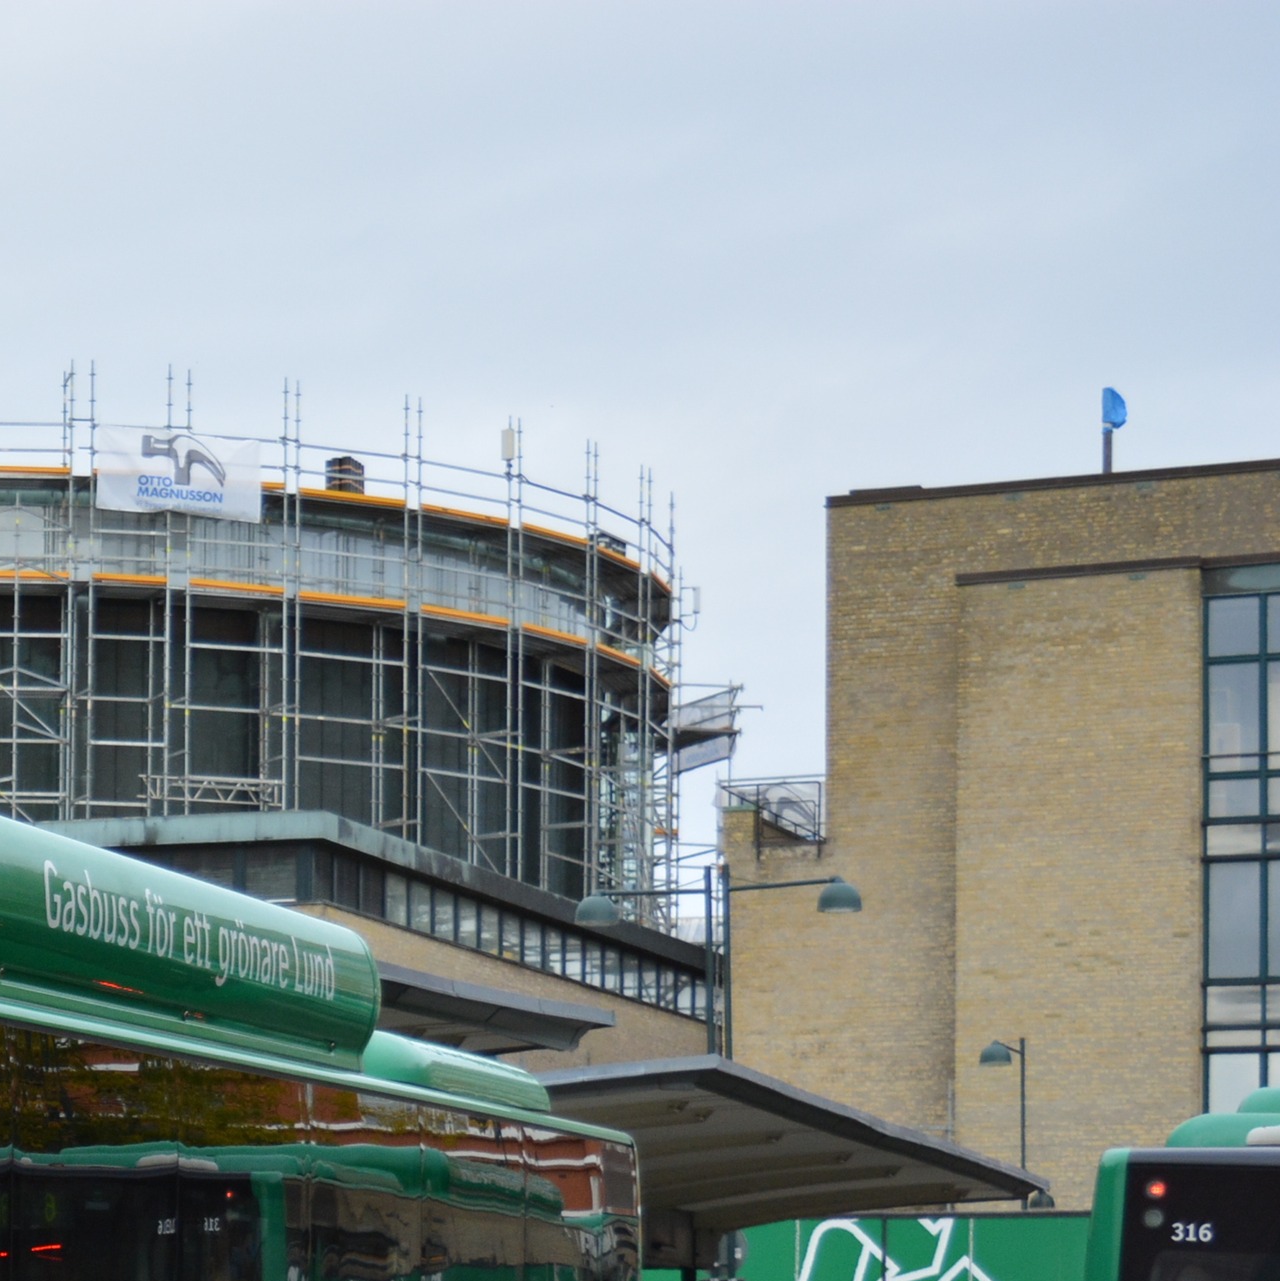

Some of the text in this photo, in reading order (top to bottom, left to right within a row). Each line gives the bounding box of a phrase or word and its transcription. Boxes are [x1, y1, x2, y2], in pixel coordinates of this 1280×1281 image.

[137, 474, 173, 488] OTTO
[136, 486, 224, 503] MAGNUSSON
[43, 859, 335, 1000] Gasbuss för ett grönare Lund
[1170, 1222, 1215, 1243] 316
